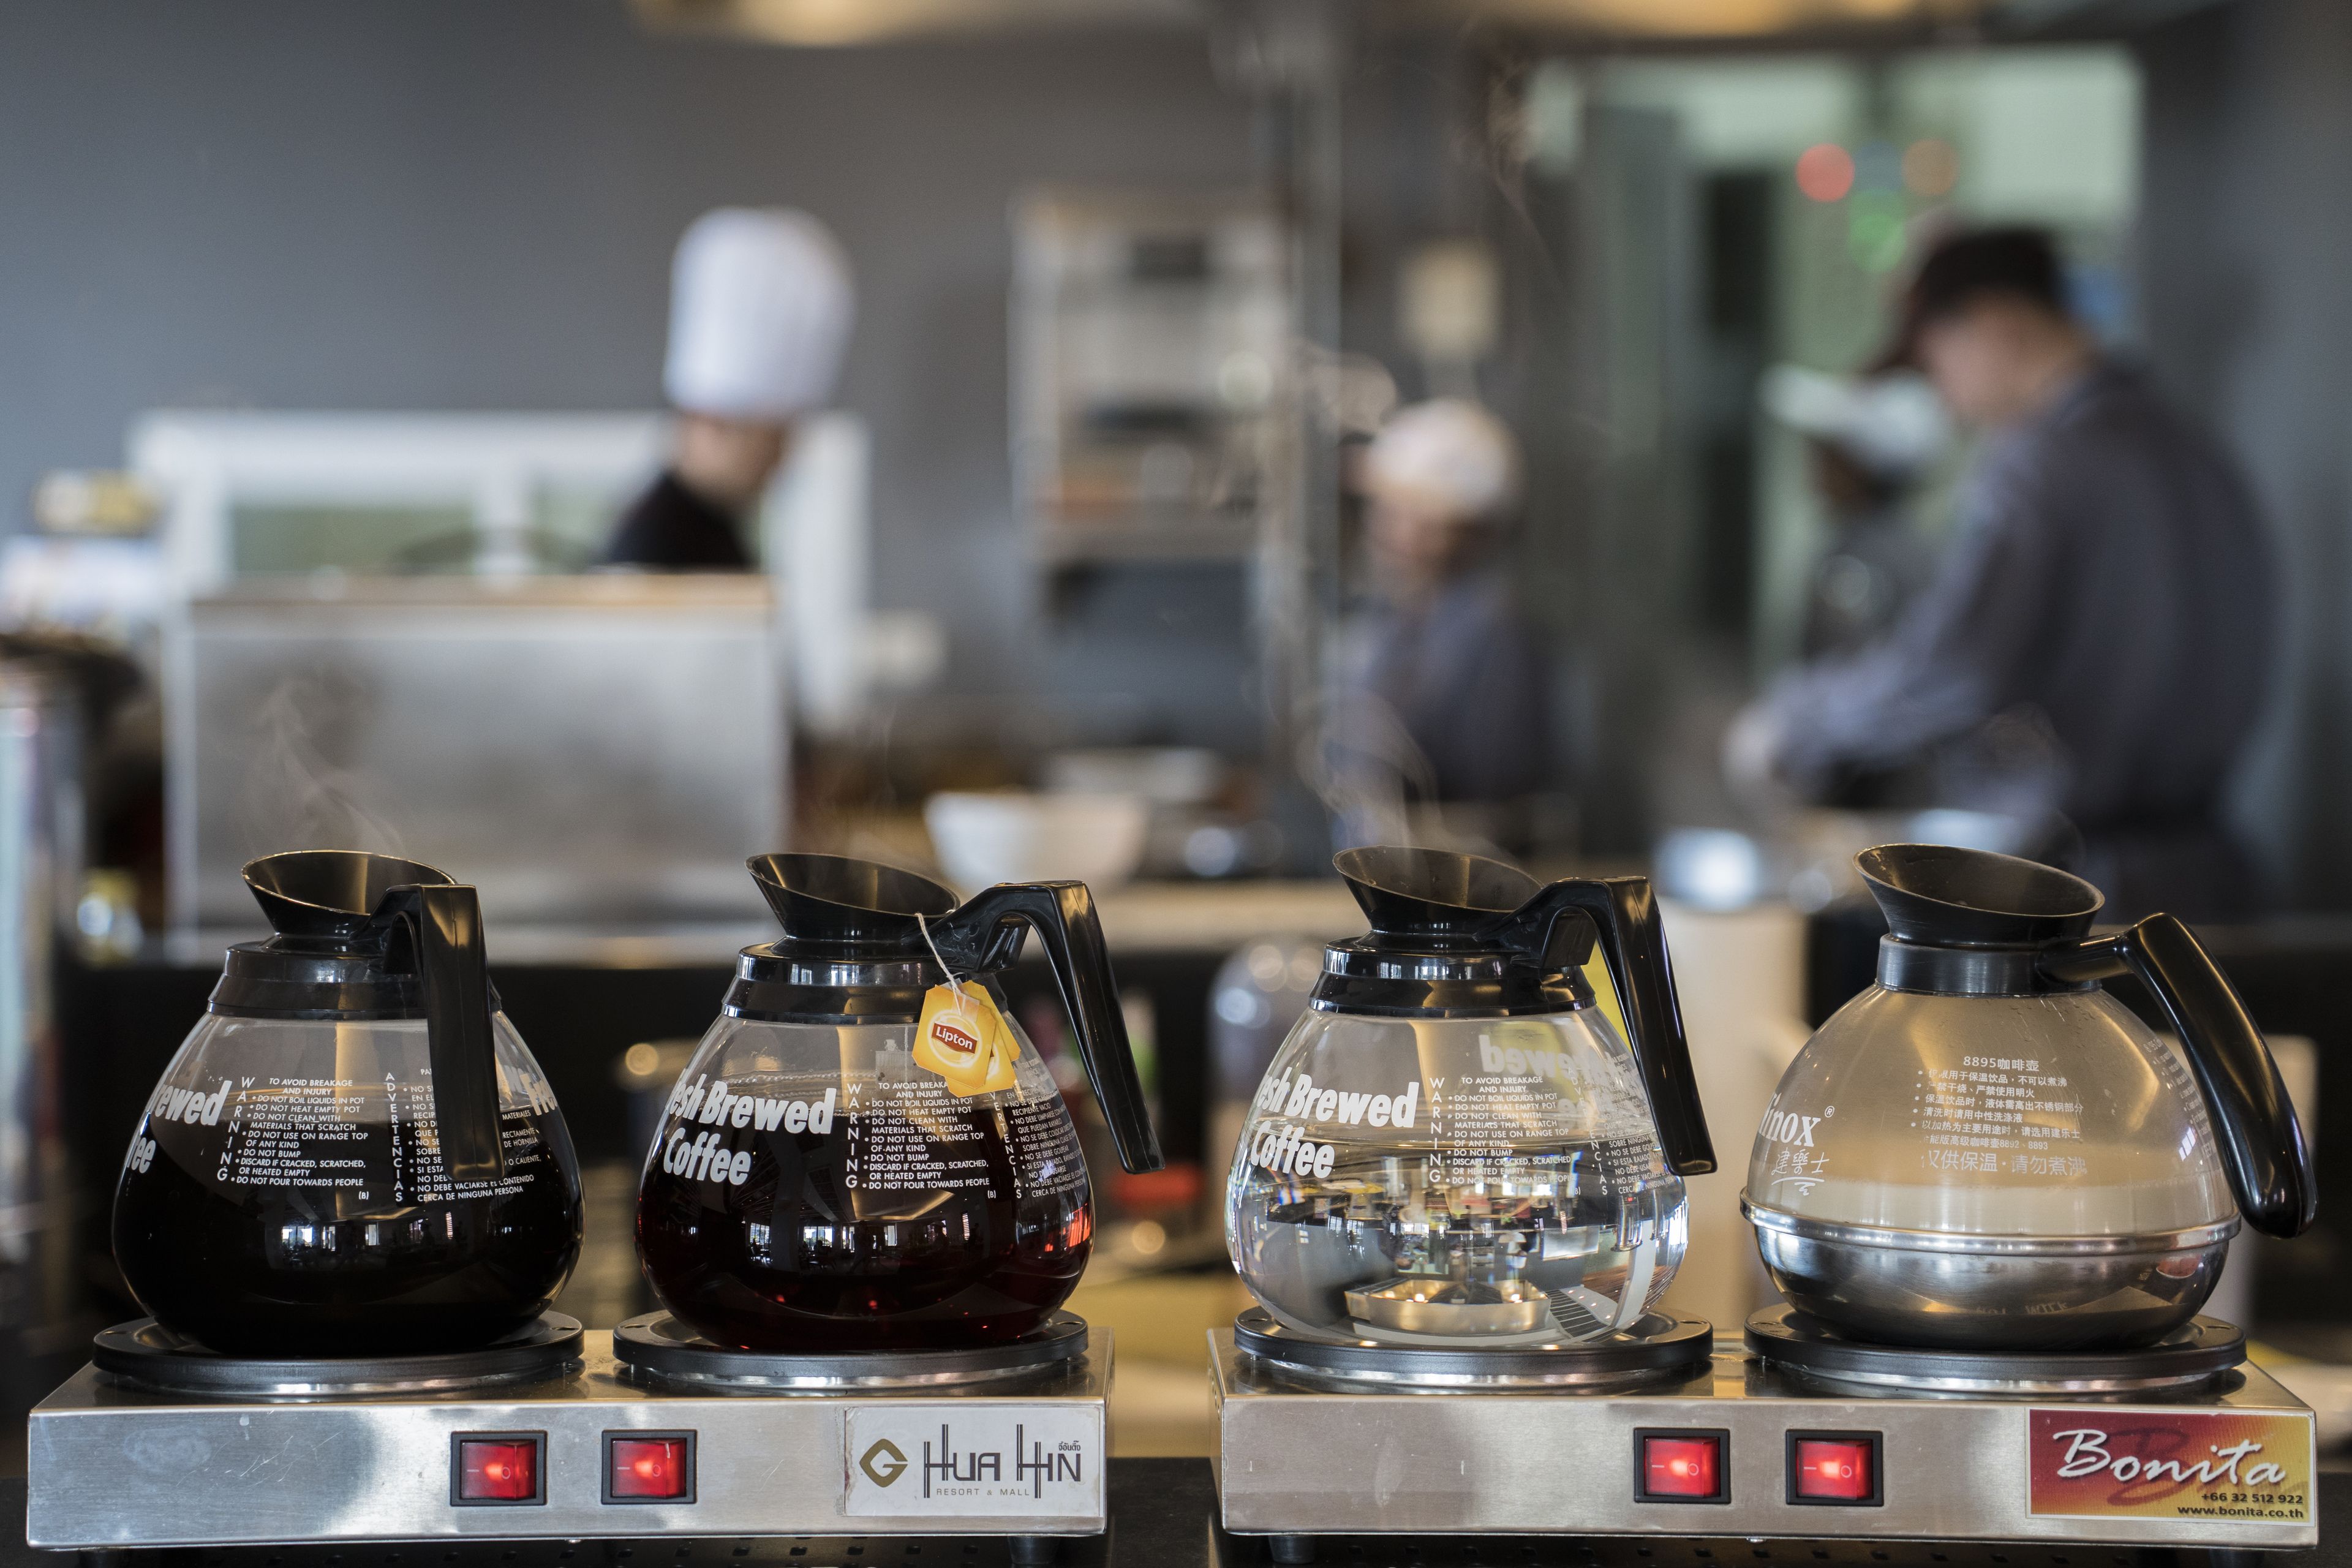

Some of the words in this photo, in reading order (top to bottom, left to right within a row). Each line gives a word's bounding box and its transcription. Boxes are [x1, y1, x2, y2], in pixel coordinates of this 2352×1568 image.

[936, 1026, 973, 1050] Lipton
[1964, 1056, 2040, 1072] 8895咖啡壶
[154, 1080, 232, 1126] rewed
[669, 1074, 707, 1120] esh
[698, 1080, 837, 1134] Brewed
[1256, 1066, 1292, 1113] esh
[1284, 1074, 1419, 1128] Brewed
[502, 1110, 531, 1120] MATERIALES
[1012, 1106, 1039, 1116] RECIPIENTE
[1759, 1093, 1821, 1147] inox
[1923, 1107, 2022, 1122] 清洗时请用中性洗涤液
[217, 1077, 255, 1181] WARNING
[386, 1072, 403, 1202] ADVERTENCIAS
[846, 1084, 862, 1188] WARNING
[1031, 1123, 1049, 1131] PUEDAN
[1429, 1077, 1445, 1182] WARNING
[513, 1137, 538, 1146] HORNILLA
[1023, 1142, 1039, 1152] SOBRE
[1040, 1139, 1060, 1149] NINGUNA
[1251, 1120, 1335, 1178] Coffee
[516, 1155, 541, 1164] CALIENTE,
[663, 1128, 751, 1185] Coffee
[949, 1160, 989, 1169] SCRATCHED,
[458, 1189, 492, 1199] NINGUNA
[924, 1424, 1000, 1498] HUA
[1017, 1424, 1081, 1499] HIN
[2053, 1429, 2286, 1486] Bonita
[2201, 1493, 2228, 1502] +66
[2231, 1493, 2247, 1502] 32
[2252, 1493, 2274, 1503] 512
[2278, 1494, 2303, 1504] 922
[2177, 1506, 2304, 1518] www.bonita.co.th
